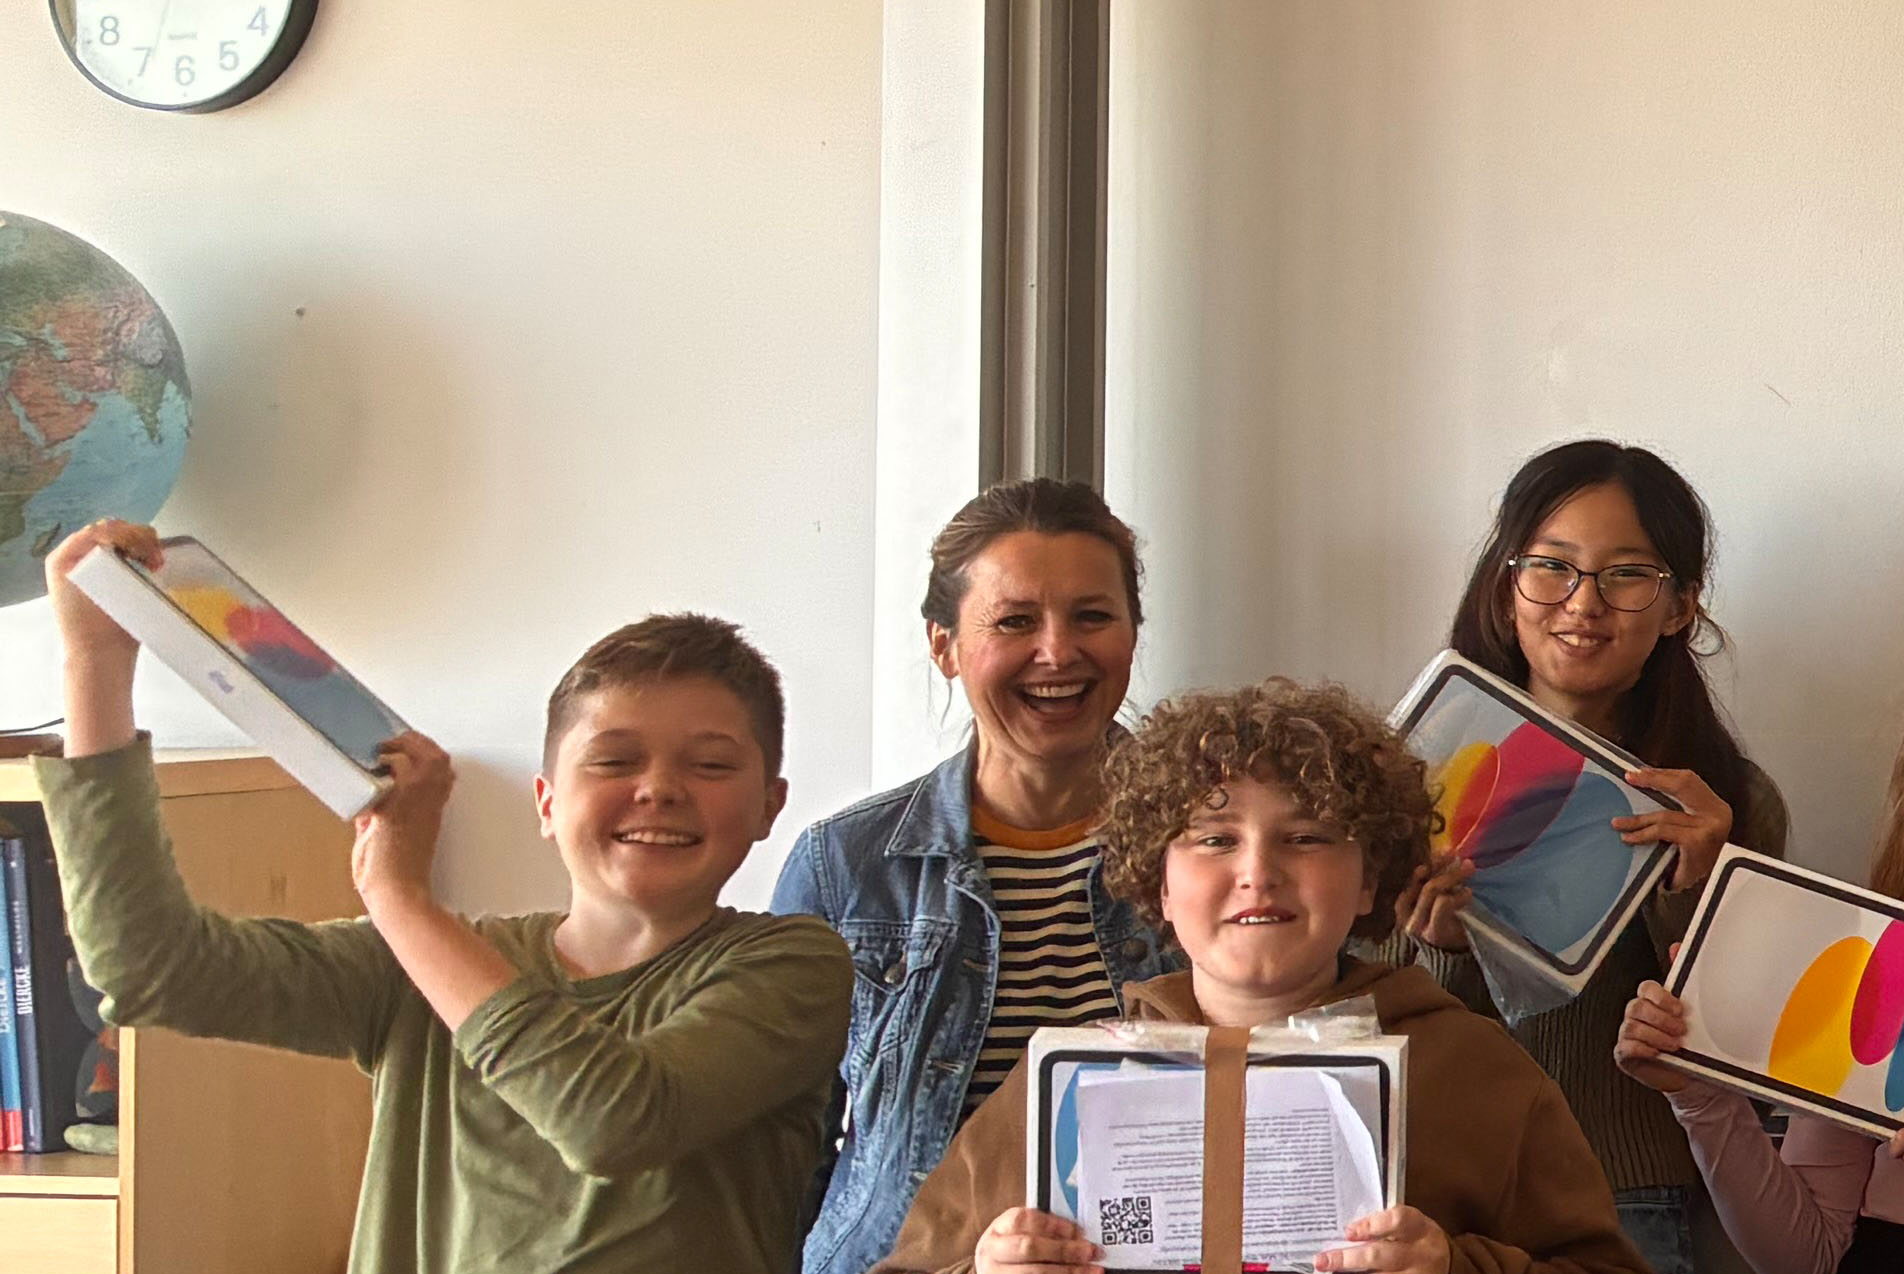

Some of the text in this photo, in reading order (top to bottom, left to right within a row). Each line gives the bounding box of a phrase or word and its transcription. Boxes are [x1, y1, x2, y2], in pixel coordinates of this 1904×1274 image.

[99, 16, 120, 45] 8
[247, 6, 269, 36] 4
[132, 46, 152, 77] 7
[175, 55, 196, 85] 6
[219, 41, 239, 71] 5
